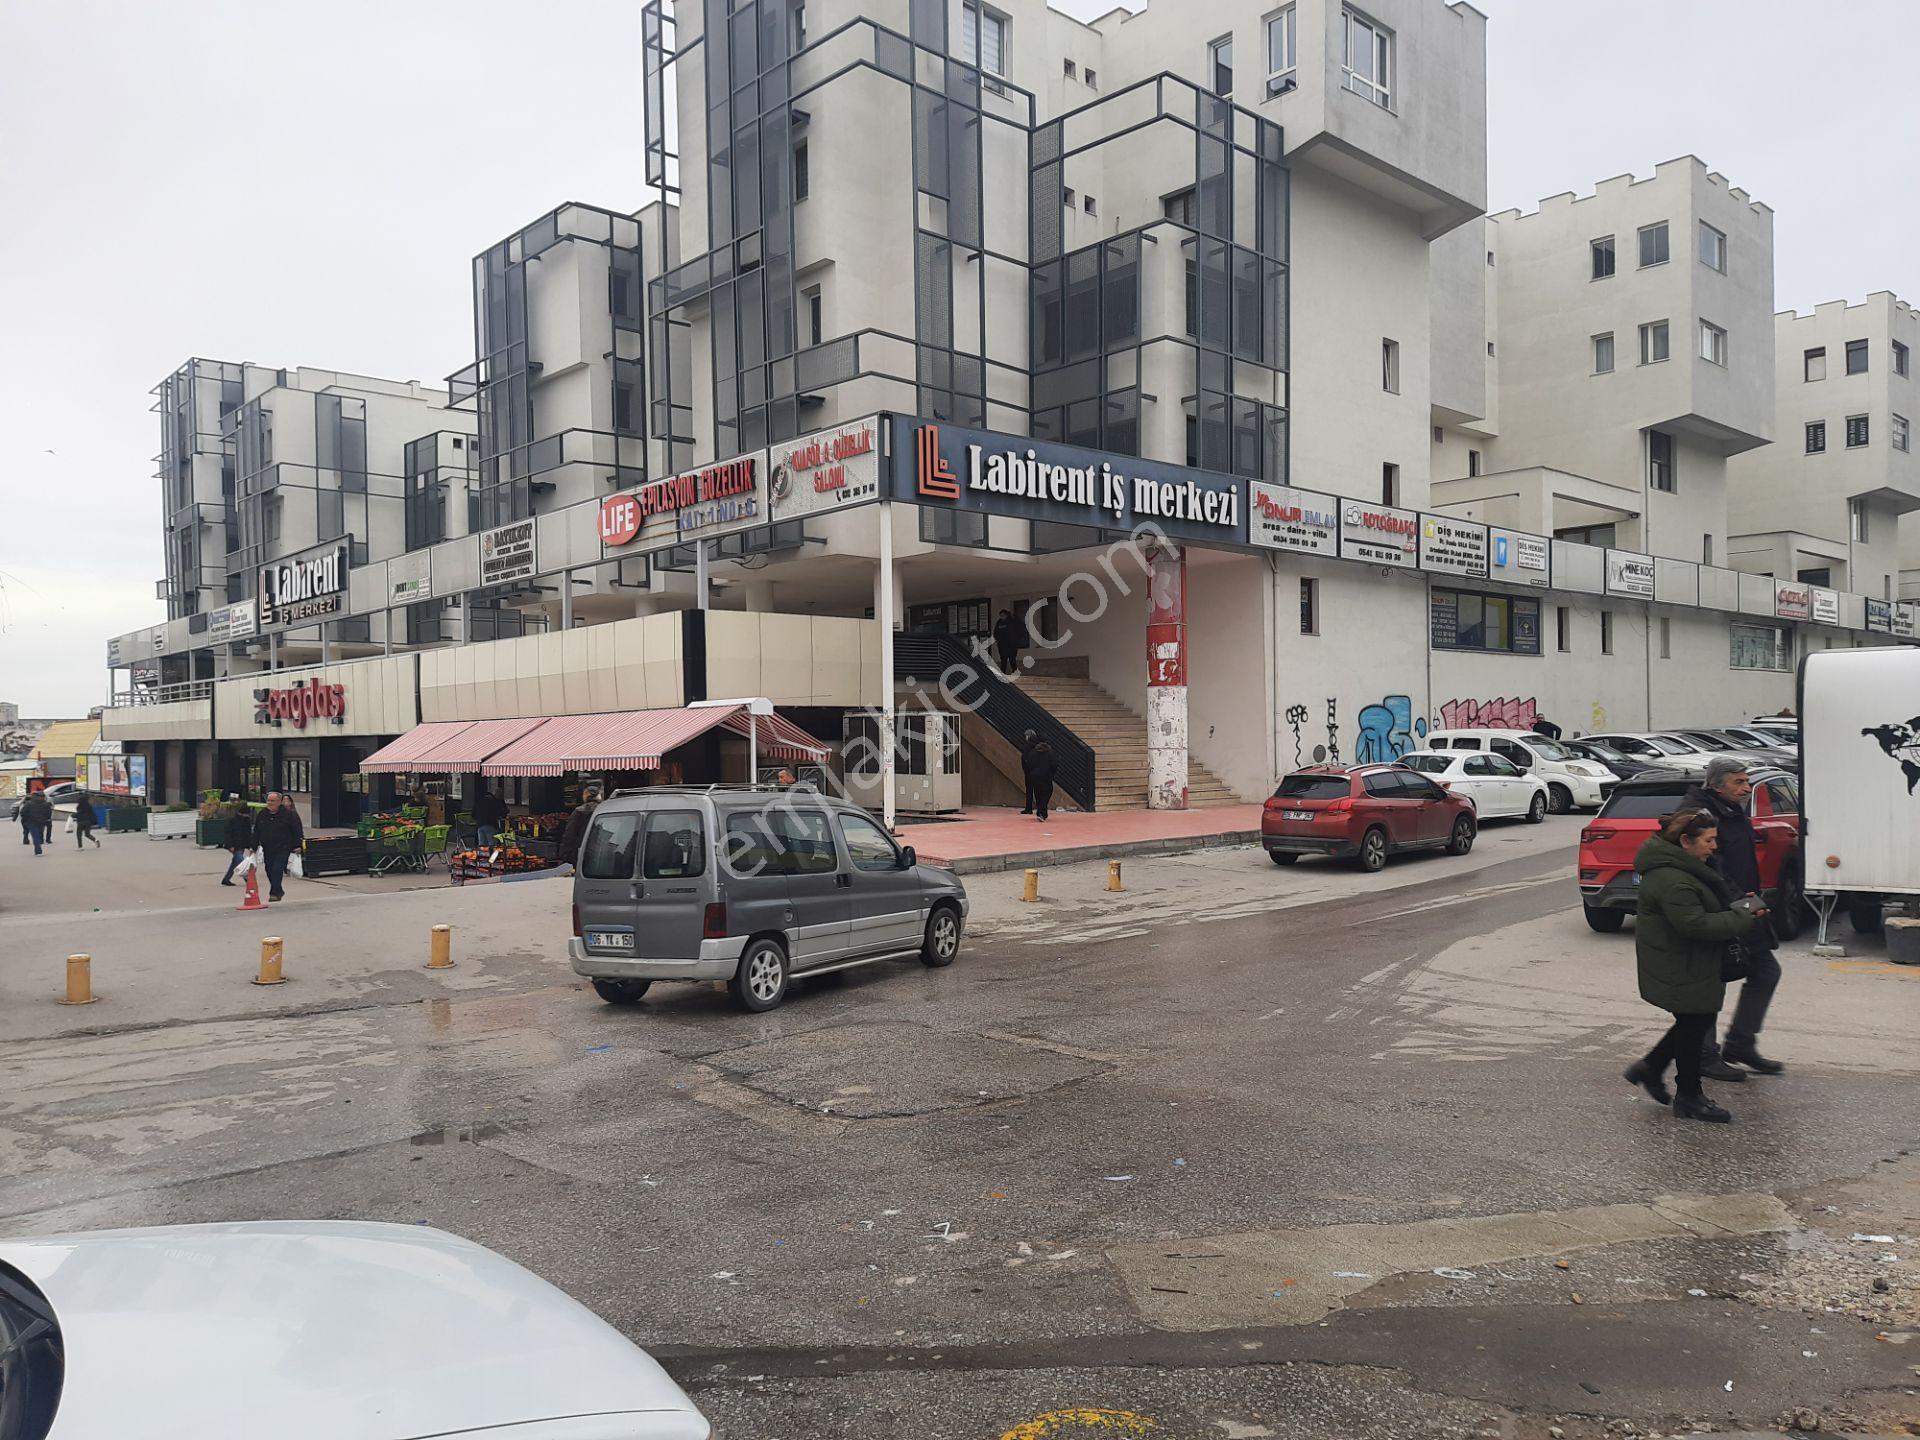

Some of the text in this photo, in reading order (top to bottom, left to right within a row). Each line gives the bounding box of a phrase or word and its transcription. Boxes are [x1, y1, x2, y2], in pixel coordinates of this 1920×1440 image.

[814, 465, 846, 493] SALONU
[968, 444, 1239, 527] Labirent iş merkezi
[602, 502, 635, 537] LIFE
[1262, 522, 1328, 539] arsa daire villa
[1437, 525, 1484, 542] DİŞ HEKİMİ
[274, 546, 340, 606] Labirent
